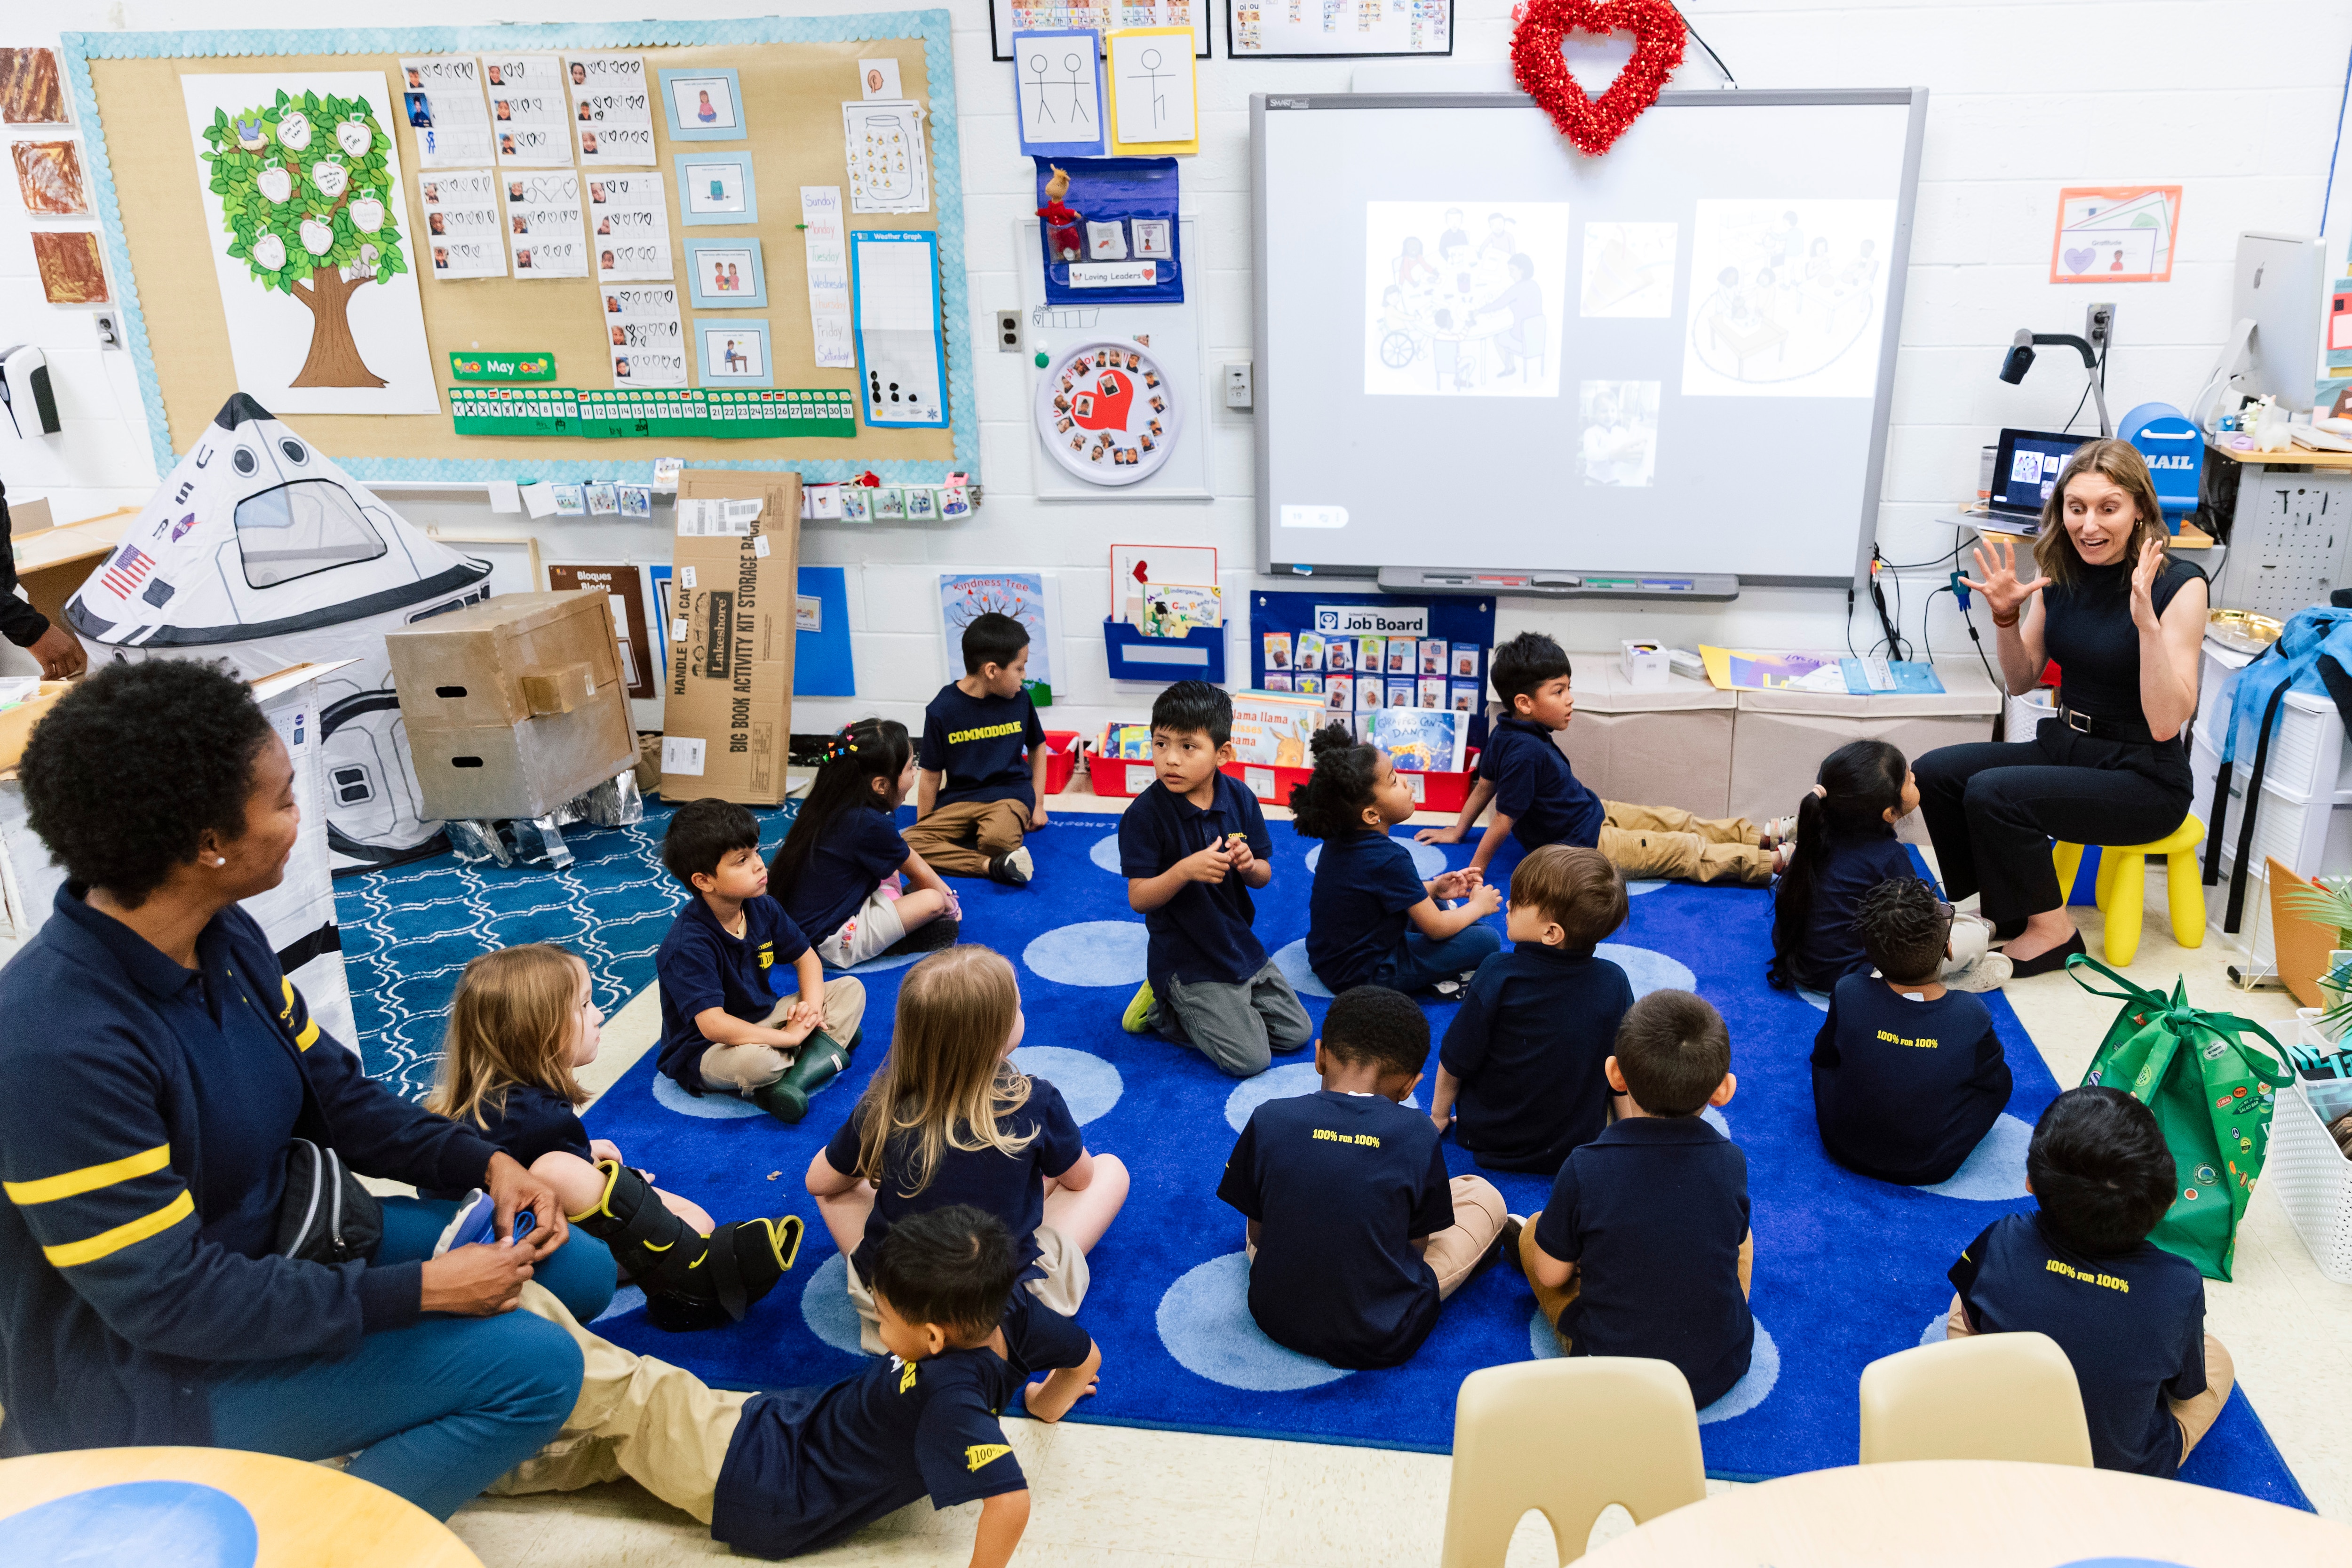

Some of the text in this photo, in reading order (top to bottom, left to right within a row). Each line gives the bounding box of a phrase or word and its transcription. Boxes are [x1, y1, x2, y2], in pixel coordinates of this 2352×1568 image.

[805, 194, 836, 207] Sunday
[807, 221, 835, 239] Monday
[809, 245, 840, 265] Tuesday
[811, 275, 847, 293] Wednesday
[1085, 273, 1107, 282] Loving
[813, 294, 846, 313] Thursday
[817, 318, 842, 341] Friday
[818, 345, 849, 367] Saturday
[487, 360, 515, 375] May
[2141, 455, 2194, 470] MAIL
[577, 571, 612, 582] Bloques
[738, 555, 757, 608] STORAGE
[953, 579, 1028, 591] Kindness Tree
[581, 582, 611, 592] Blocks
[1147, 587, 1203, 604] Miss Bindergarten
[1172, 602, 1187, 611] Gets
[1189, 599, 1210, 610] Ready
[737, 612, 755, 632] KIT
[1344, 617, 1422, 630] Job Board
[712, 598, 727, 672] Lakeshore
[675, 647, 687, 695] HANDLE
[733, 637, 754, 693] ACTIVITY
[731, 698, 751, 729] BOOK
[1232, 709, 1288, 724] lama llama
[1378, 716, 1417, 728] GIRAFFES
[948, 721, 1022, 744] COMMODORE
[1392, 728, 1429, 738] DANCE
[730, 733, 748, 753] BIG
[1877, 1030, 1899, 1044] 100%
[1915, 1038, 1938, 1049] 100%
[1312, 1129, 1380, 1148] 100% FOR 100%
[2046, 1259, 2129, 1293] 100% FOR 100%
[975, 1447, 1002, 1463] 100%
